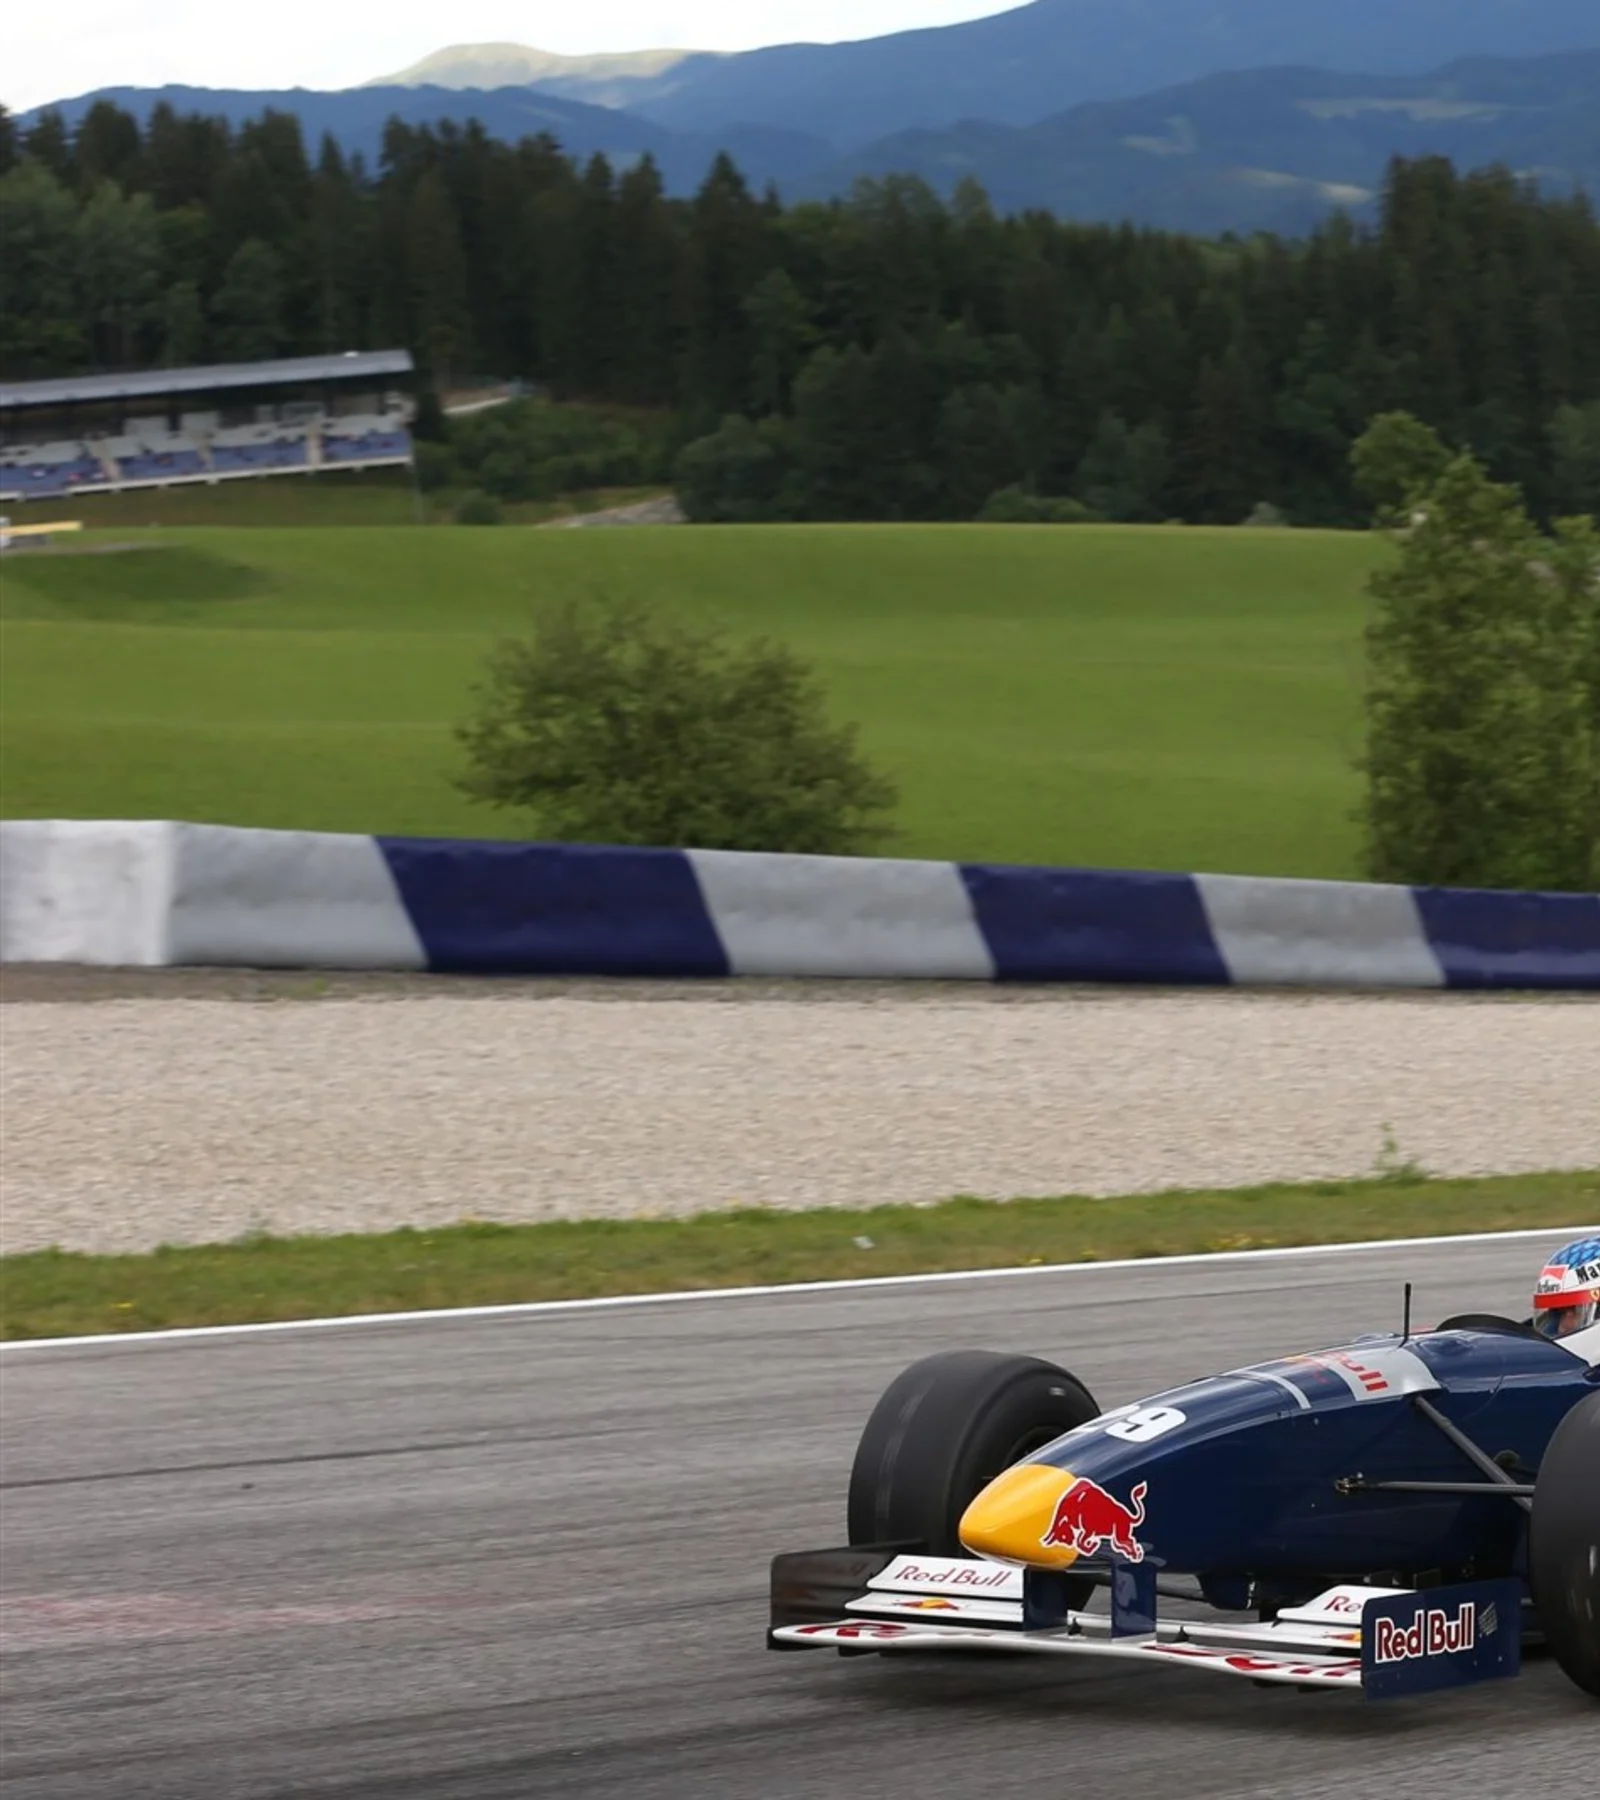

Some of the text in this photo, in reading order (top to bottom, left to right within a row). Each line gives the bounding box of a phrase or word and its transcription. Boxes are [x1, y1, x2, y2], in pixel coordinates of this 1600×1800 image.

[894, 1565, 1011, 1587] Red Bull
[1324, 1595, 1363, 1613] Re
[1375, 1611, 1424, 1663] Red
[1427, 1603, 1475, 1654] Bull
